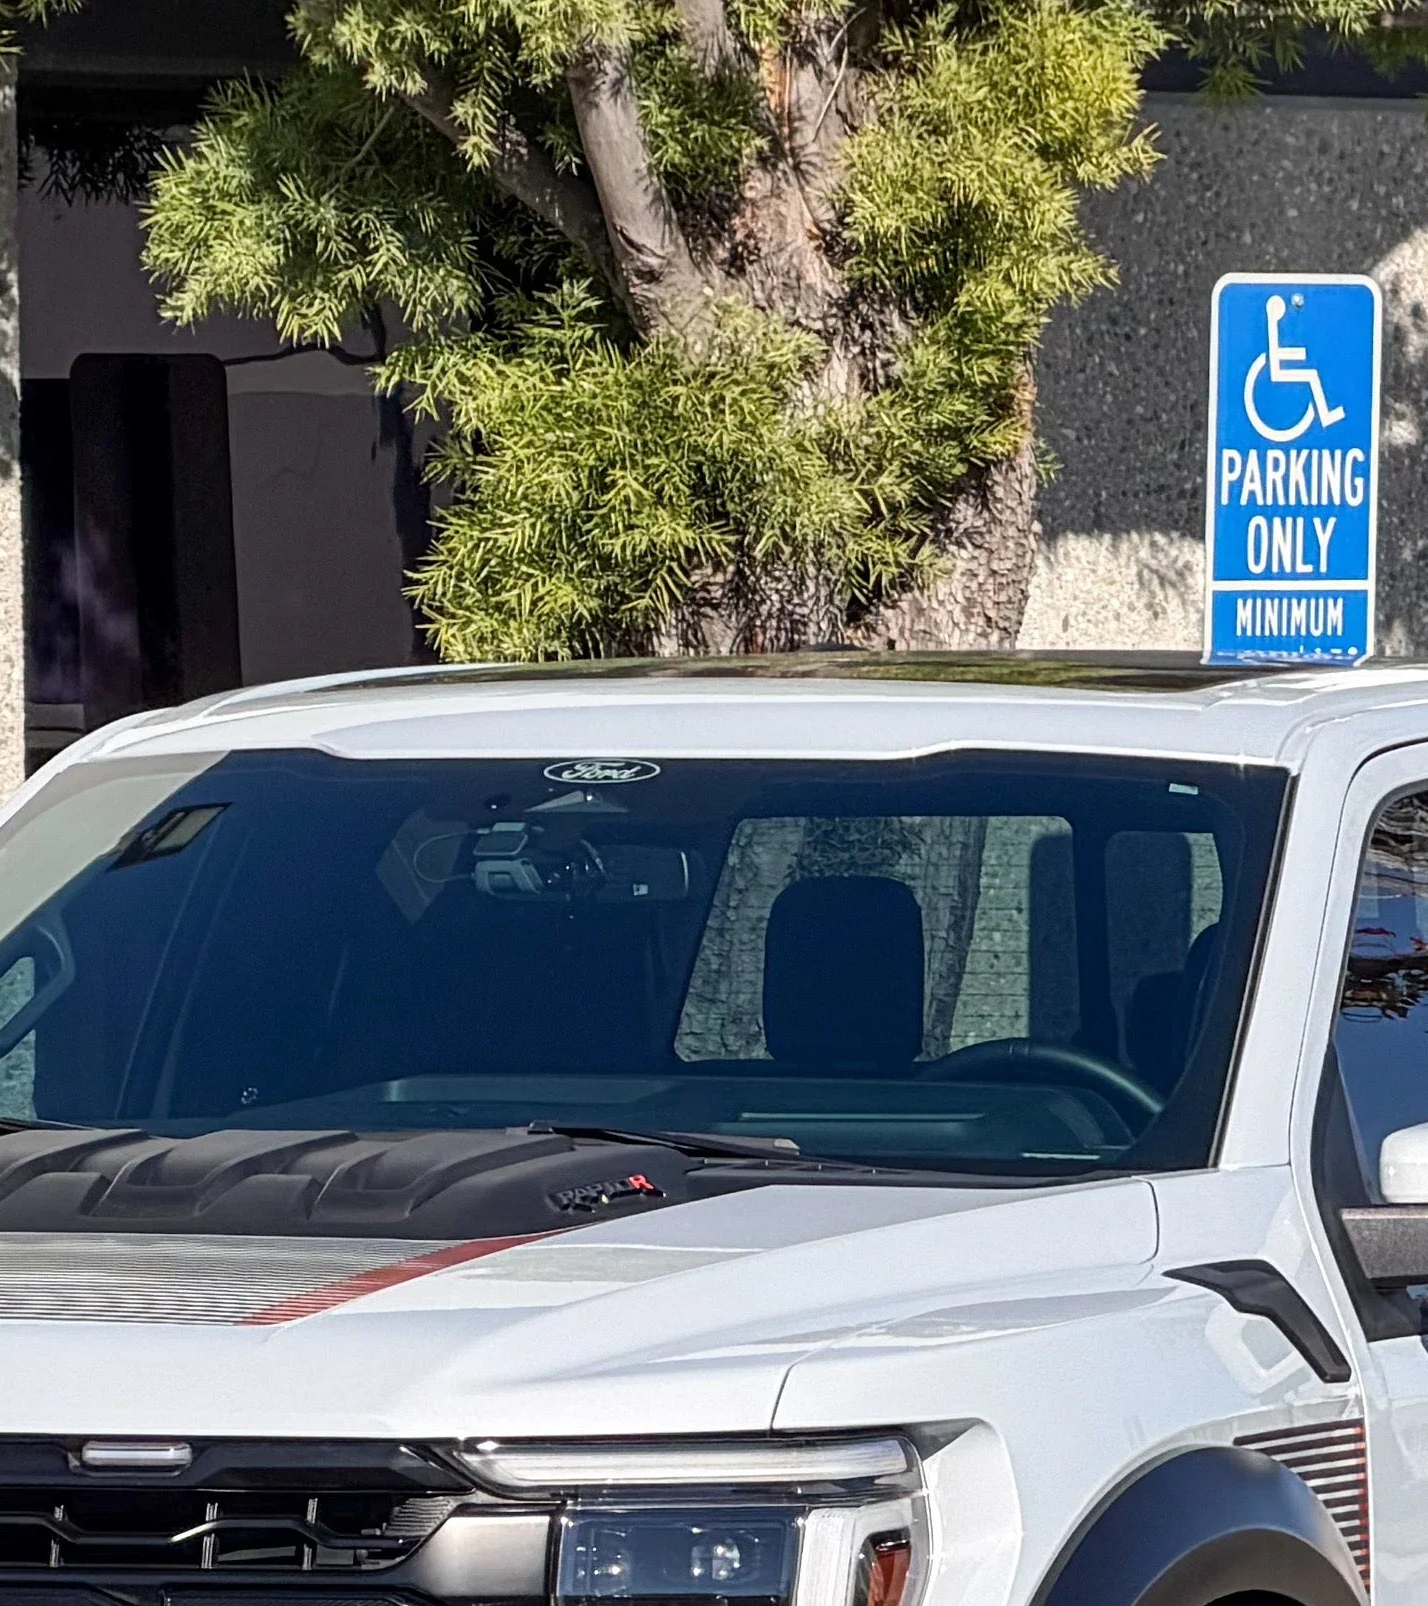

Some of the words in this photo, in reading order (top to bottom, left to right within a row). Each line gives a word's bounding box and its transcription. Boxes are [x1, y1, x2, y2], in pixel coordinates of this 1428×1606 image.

[1220, 447, 1365, 507] PARKING
[1246, 516, 1337, 574] ONLY
[1236, 597, 1343, 637] MINIMUM
[561, 761, 642, 779] Ford
